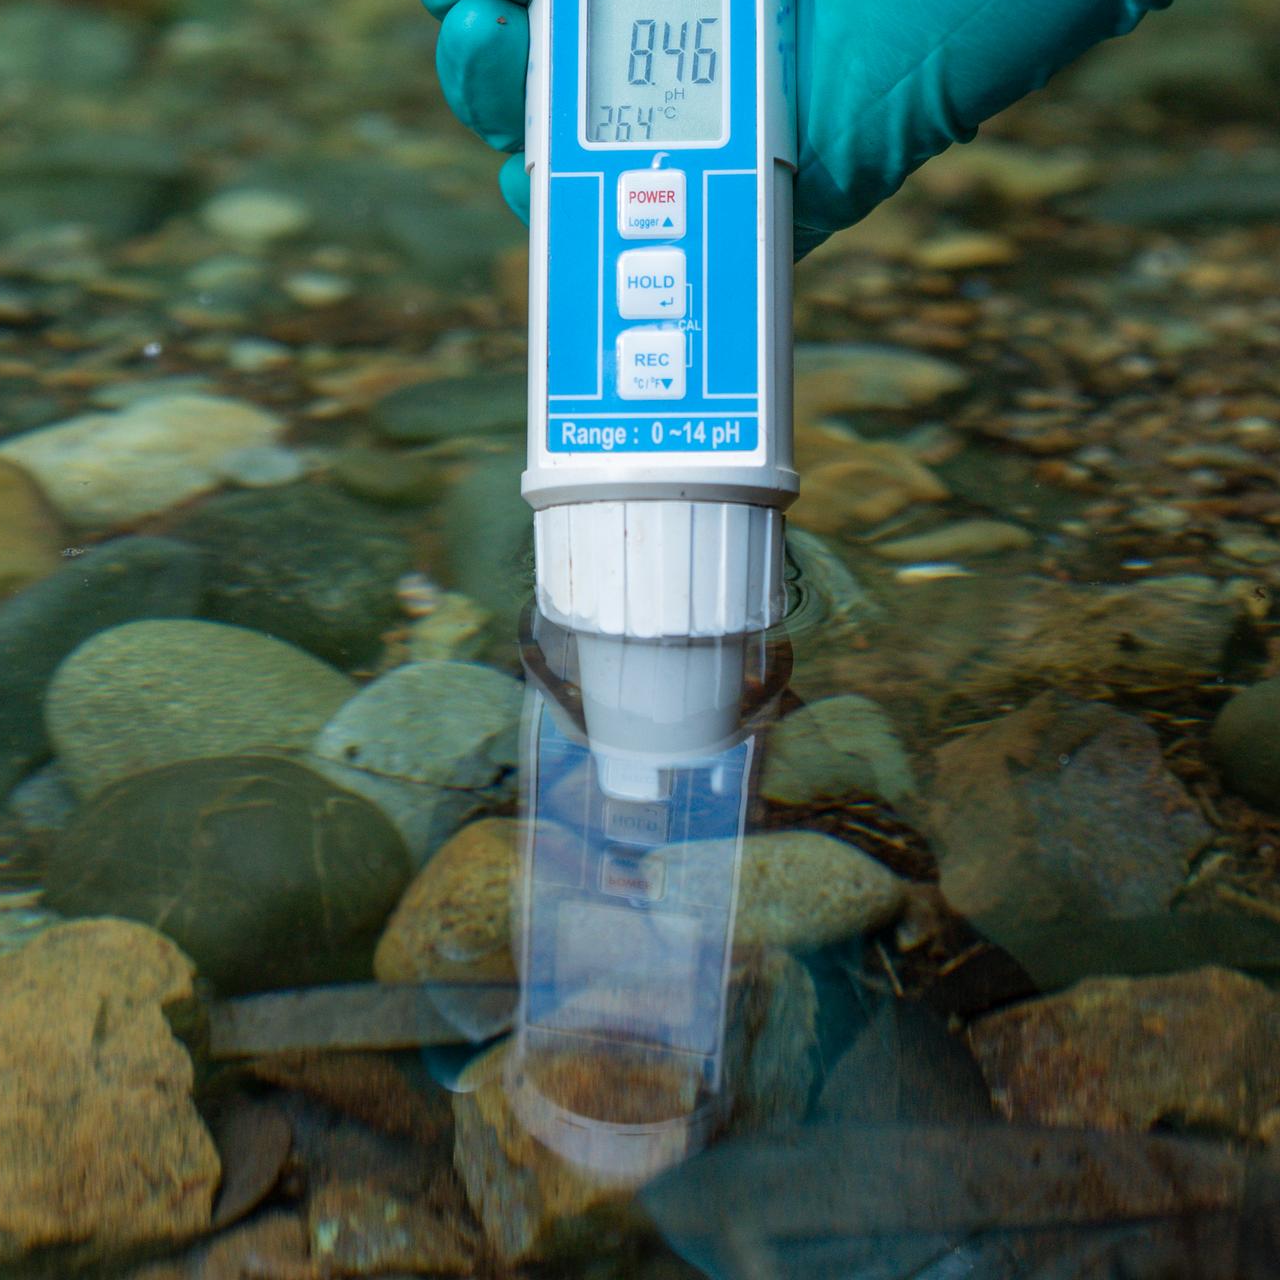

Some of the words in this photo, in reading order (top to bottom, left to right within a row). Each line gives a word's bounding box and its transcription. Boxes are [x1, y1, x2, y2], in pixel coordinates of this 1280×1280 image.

[628, 17, 719, 86] 8.46
[664, 88, 685, 103] pH
[629, 190, 675, 203] POWER
[629, 216, 659, 228] Logger
[628, 276, 675, 289] HOLD
[678, 319, 701, 331] CAL
[634, 353, 669, 367] REC
[712, 422, 740, 448] pH
